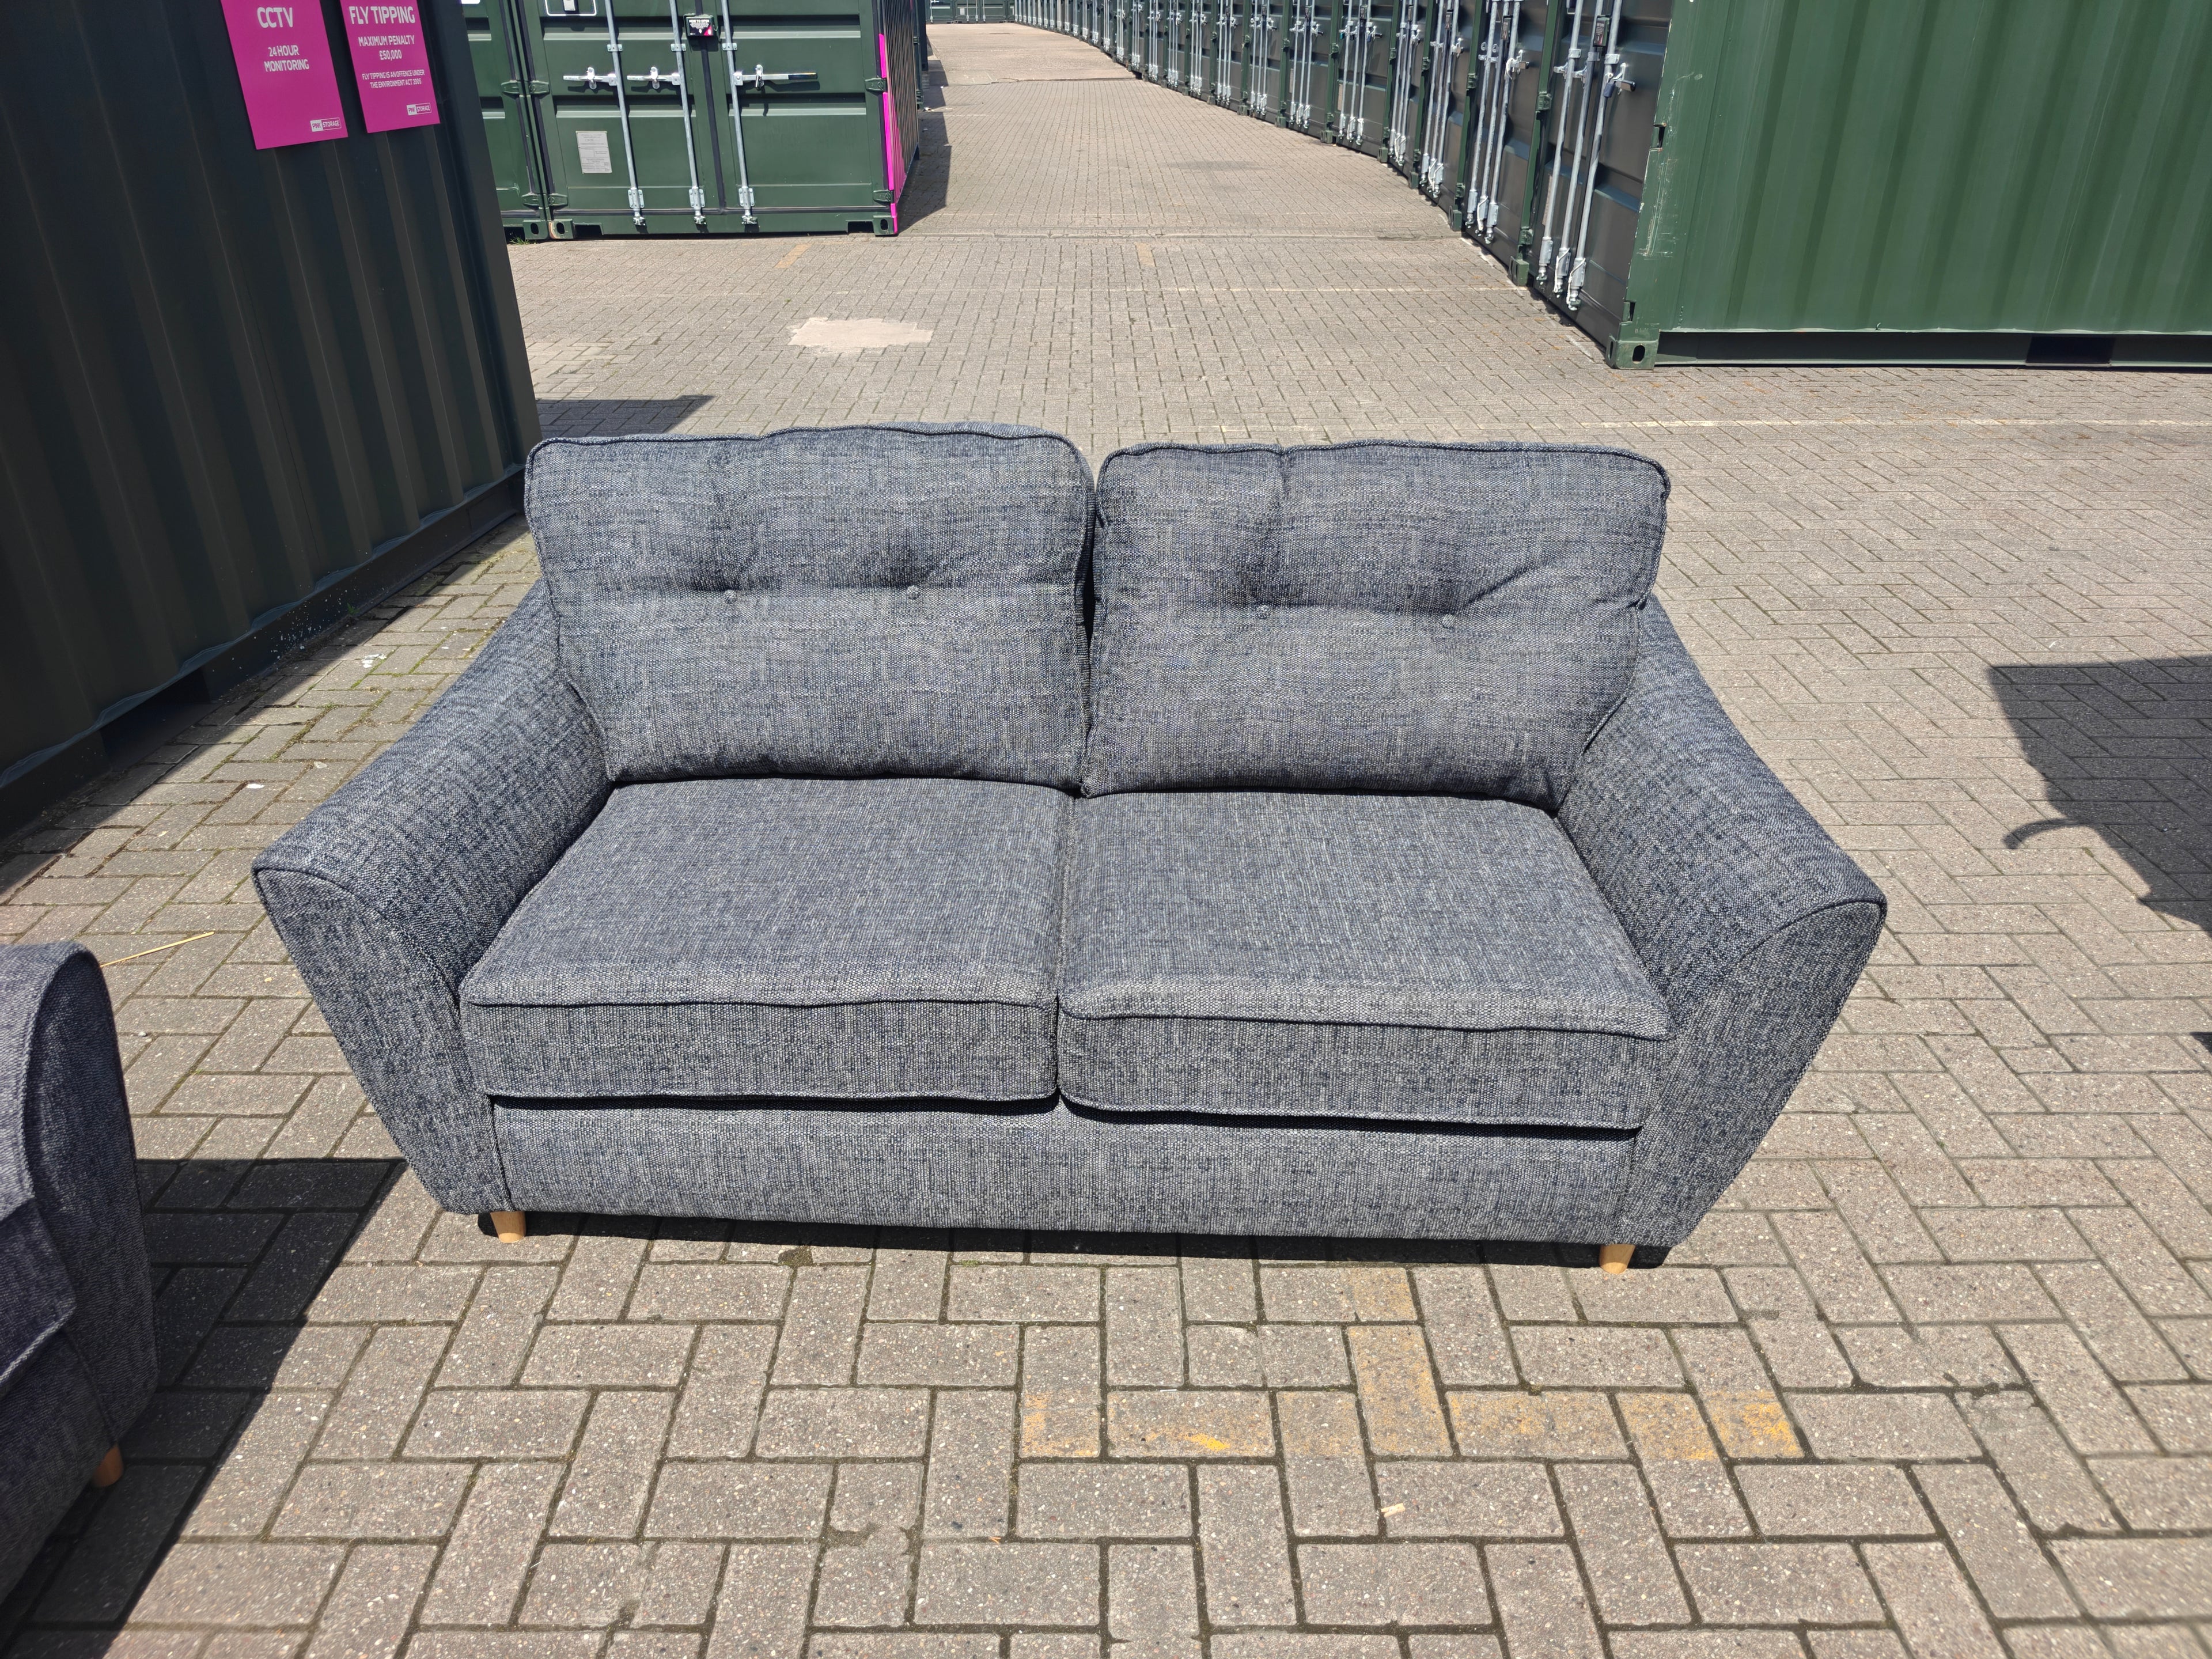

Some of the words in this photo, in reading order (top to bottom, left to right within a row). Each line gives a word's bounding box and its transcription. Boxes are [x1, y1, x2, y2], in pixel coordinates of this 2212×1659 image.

[257, 7, 293, 28] CCTV
[349, 6, 369, 24] FLY
[370, 6, 415, 24] TIPPING
[358, 36, 388, 46] MAXIMUM
[388, 35, 415, 45] PENALTY
[268, 47, 277, 56] 24
[276, 45, 300, 56] HOUR
[379, 50, 402, 60] £50,000
[264, 59, 309, 72] MONITORING
[378, 80, 405, 88] ENVIRONMENT
